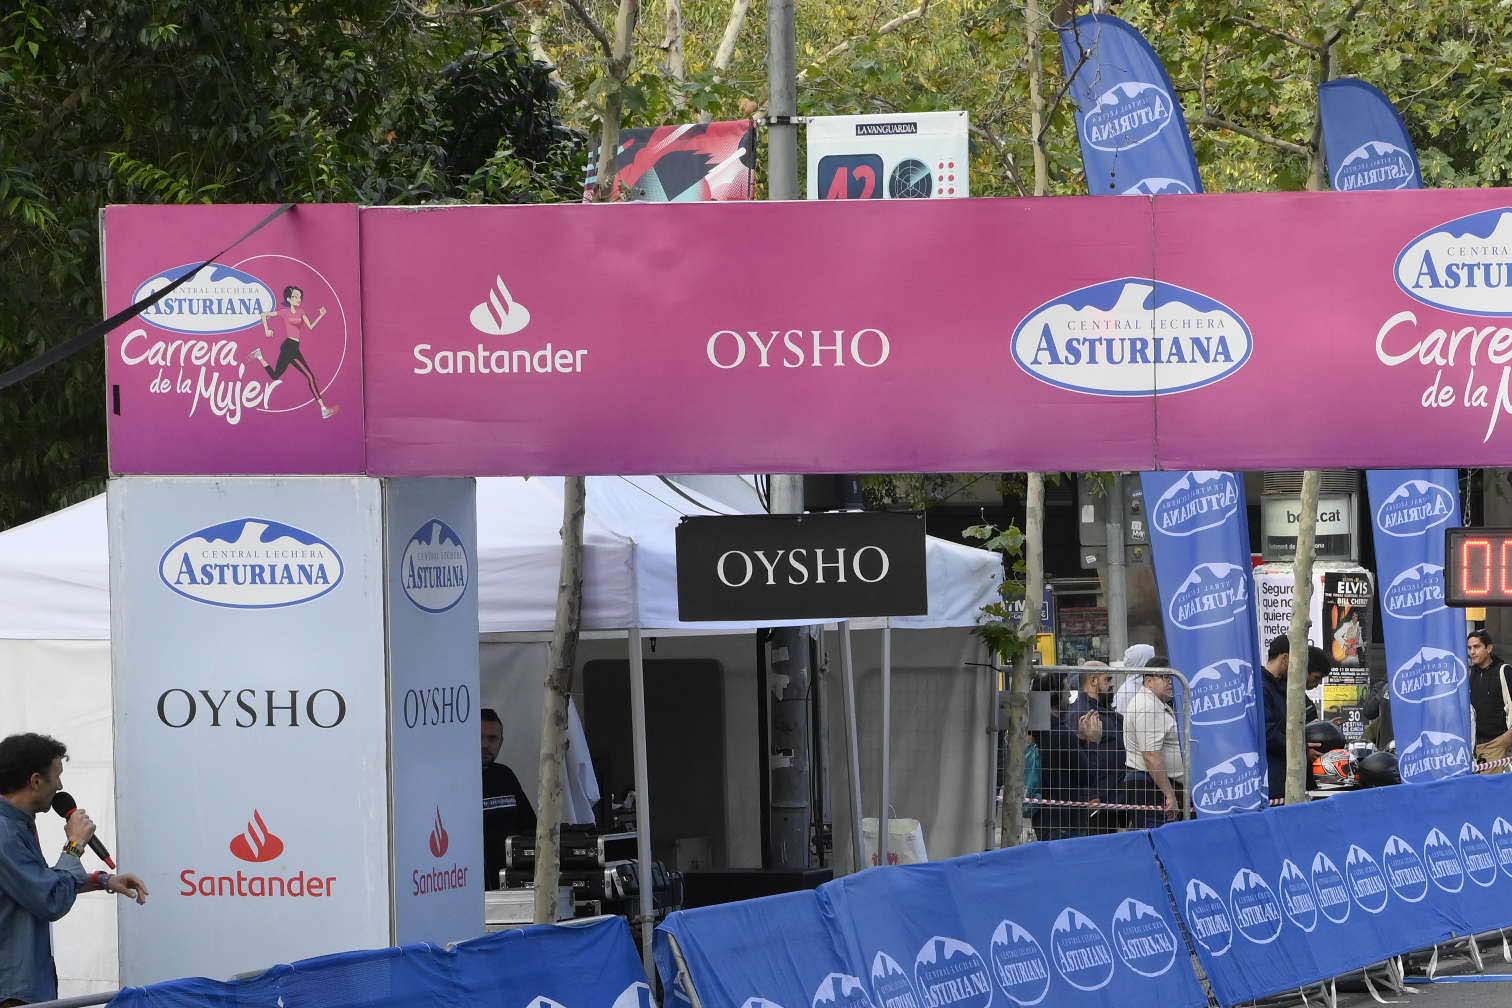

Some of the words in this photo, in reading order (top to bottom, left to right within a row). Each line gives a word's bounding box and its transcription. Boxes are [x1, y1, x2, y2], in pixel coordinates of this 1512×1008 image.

[857, 126, 866, 135] LA
[866, 124, 917, 135] VANGUARDIA
[1066, 318, 1142, 331] CENTRAL
[1149, 317, 1226, 331] LECHERA
[120, 328, 238, 367] Carrera
[413, 344, 587, 375] Santander
[706, 328, 890, 370] OYSHO
[1032, 321, 1235, 367] ASTURIANA
[150, 368, 171, 394] de
[176, 365, 192, 394] la
[189, 362, 283, 425] Mujer
[1421, 370, 1455, 409] de
[1463, 366, 1489, 409] la
[174, 551, 330, 586] ASTURIANA
[202, 550, 259, 559] CENTRAL
[265, 550, 324, 559] LECHERA
[716, 545, 890, 587] OYSHO
[406, 557, 465, 590] ASTURIANA
[1337, 581, 1368, 595] ELVIS
[1263, 598, 1279, 608] que
[157, 688, 347, 729] OYSHO
[404, 684, 471, 729] OYSHO
[1348, 710, 1361, 722] 30
[179, 869, 337, 898] Santander
[412, 863, 469, 897] Santander
[996, 954, 1048, 987] ASTURIANA
[1057, 941, 1112, 973] ASTURIANA
